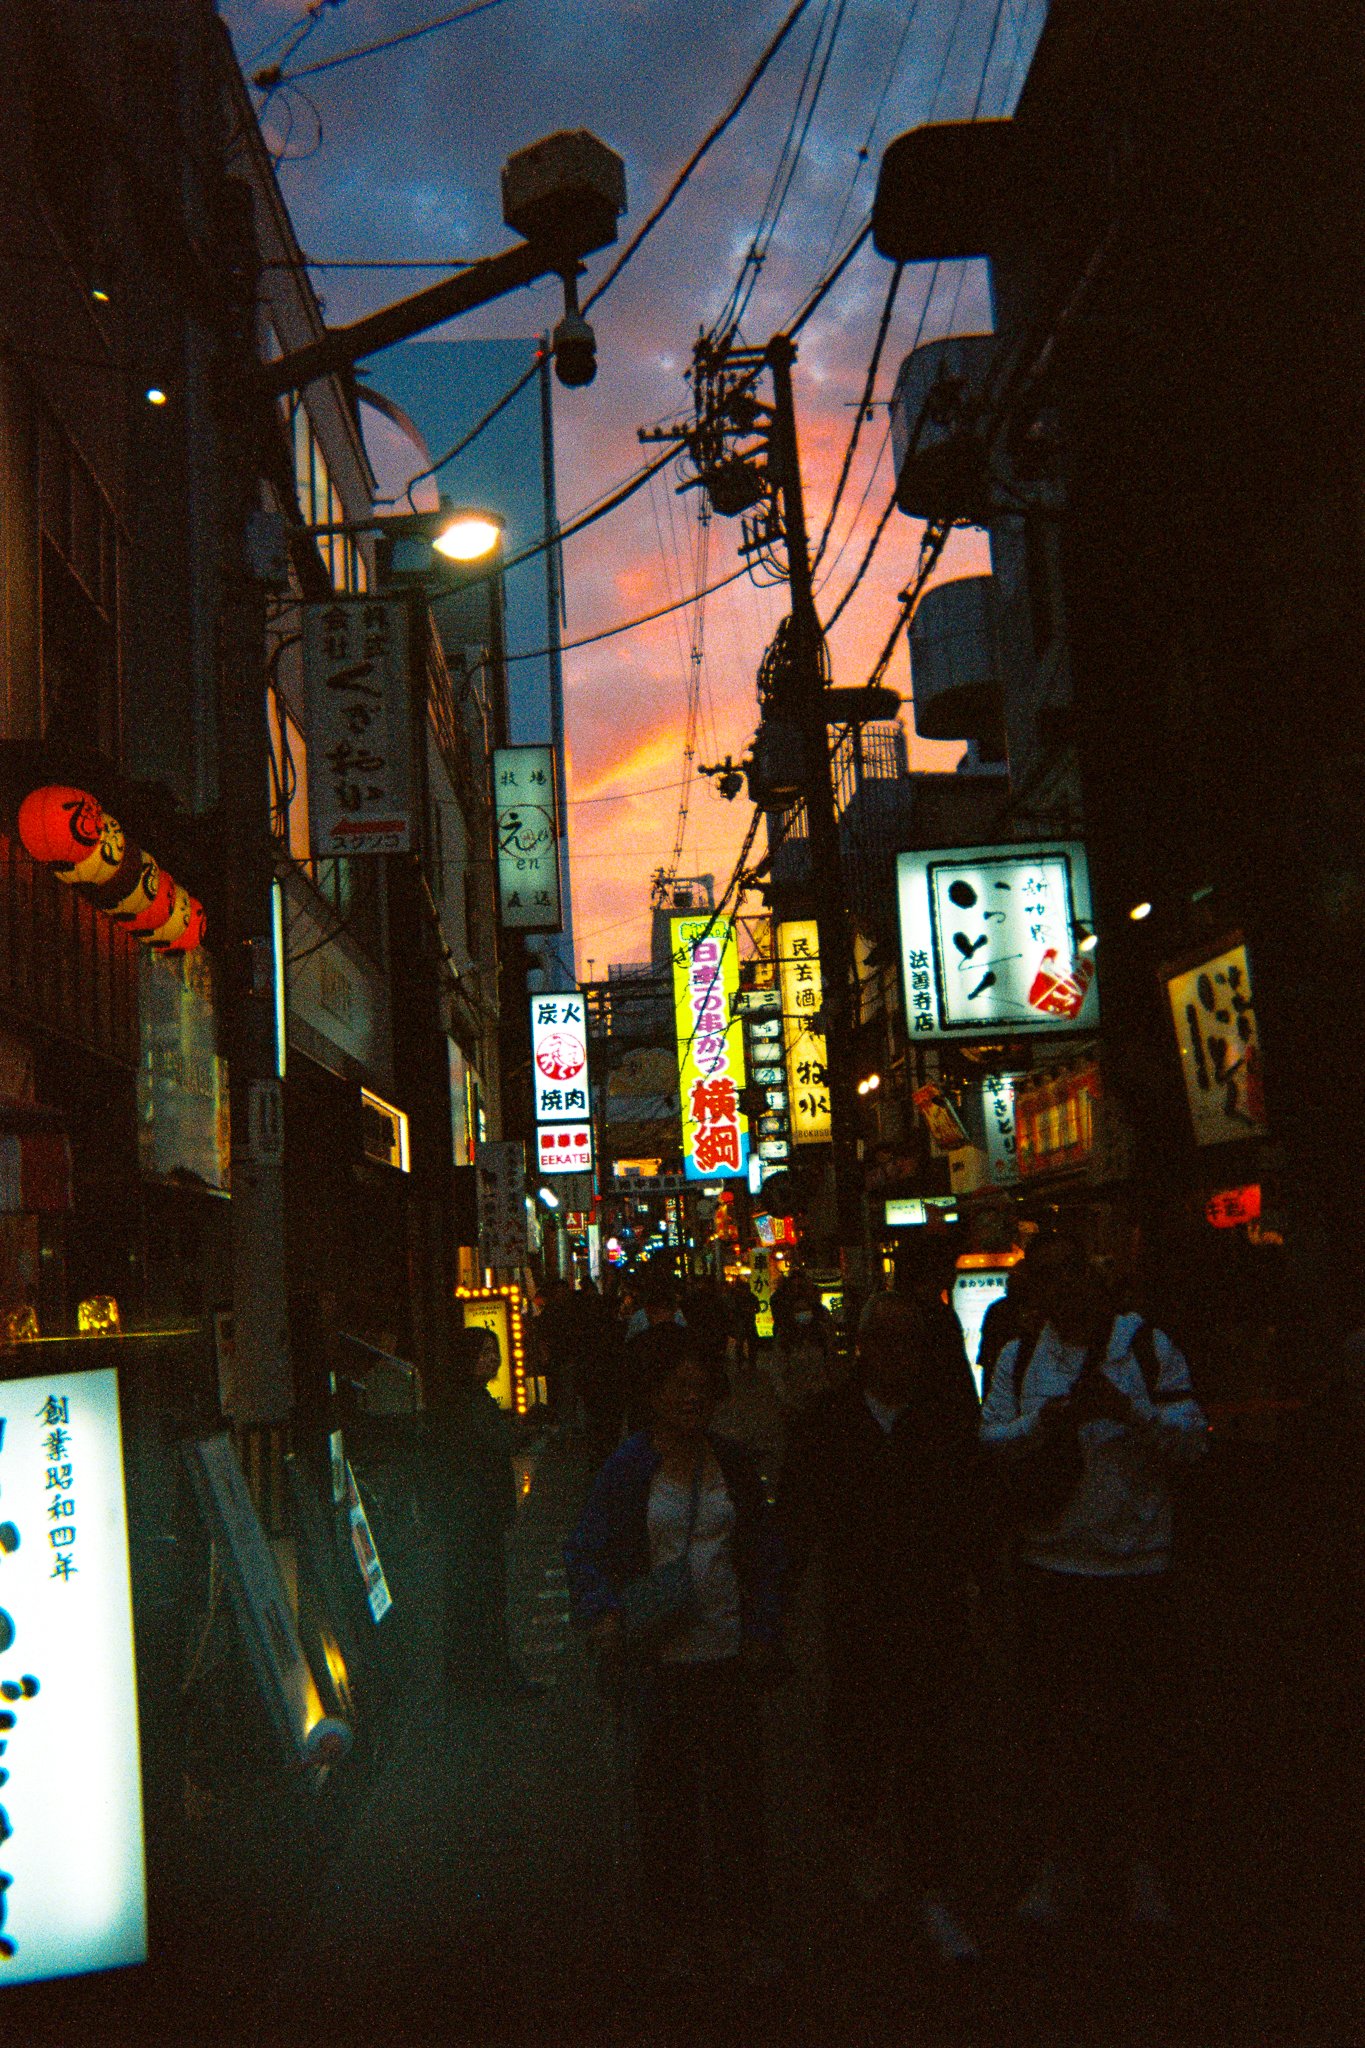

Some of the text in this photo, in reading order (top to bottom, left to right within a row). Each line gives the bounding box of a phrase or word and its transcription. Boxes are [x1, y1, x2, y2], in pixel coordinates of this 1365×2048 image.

[516, 858, 540, 871] en
[537, 1002, 582, 1025] 炭火
[909, 951, 935, 1031] 法善寺店
[540, 1088, 585, 1111] 焼肉
[691, 1079, 739, 1170] 横綱
[987, 1077, 1017, 1155] やきとり
[35, 1393, 78, 1583] 創業昭和四年
